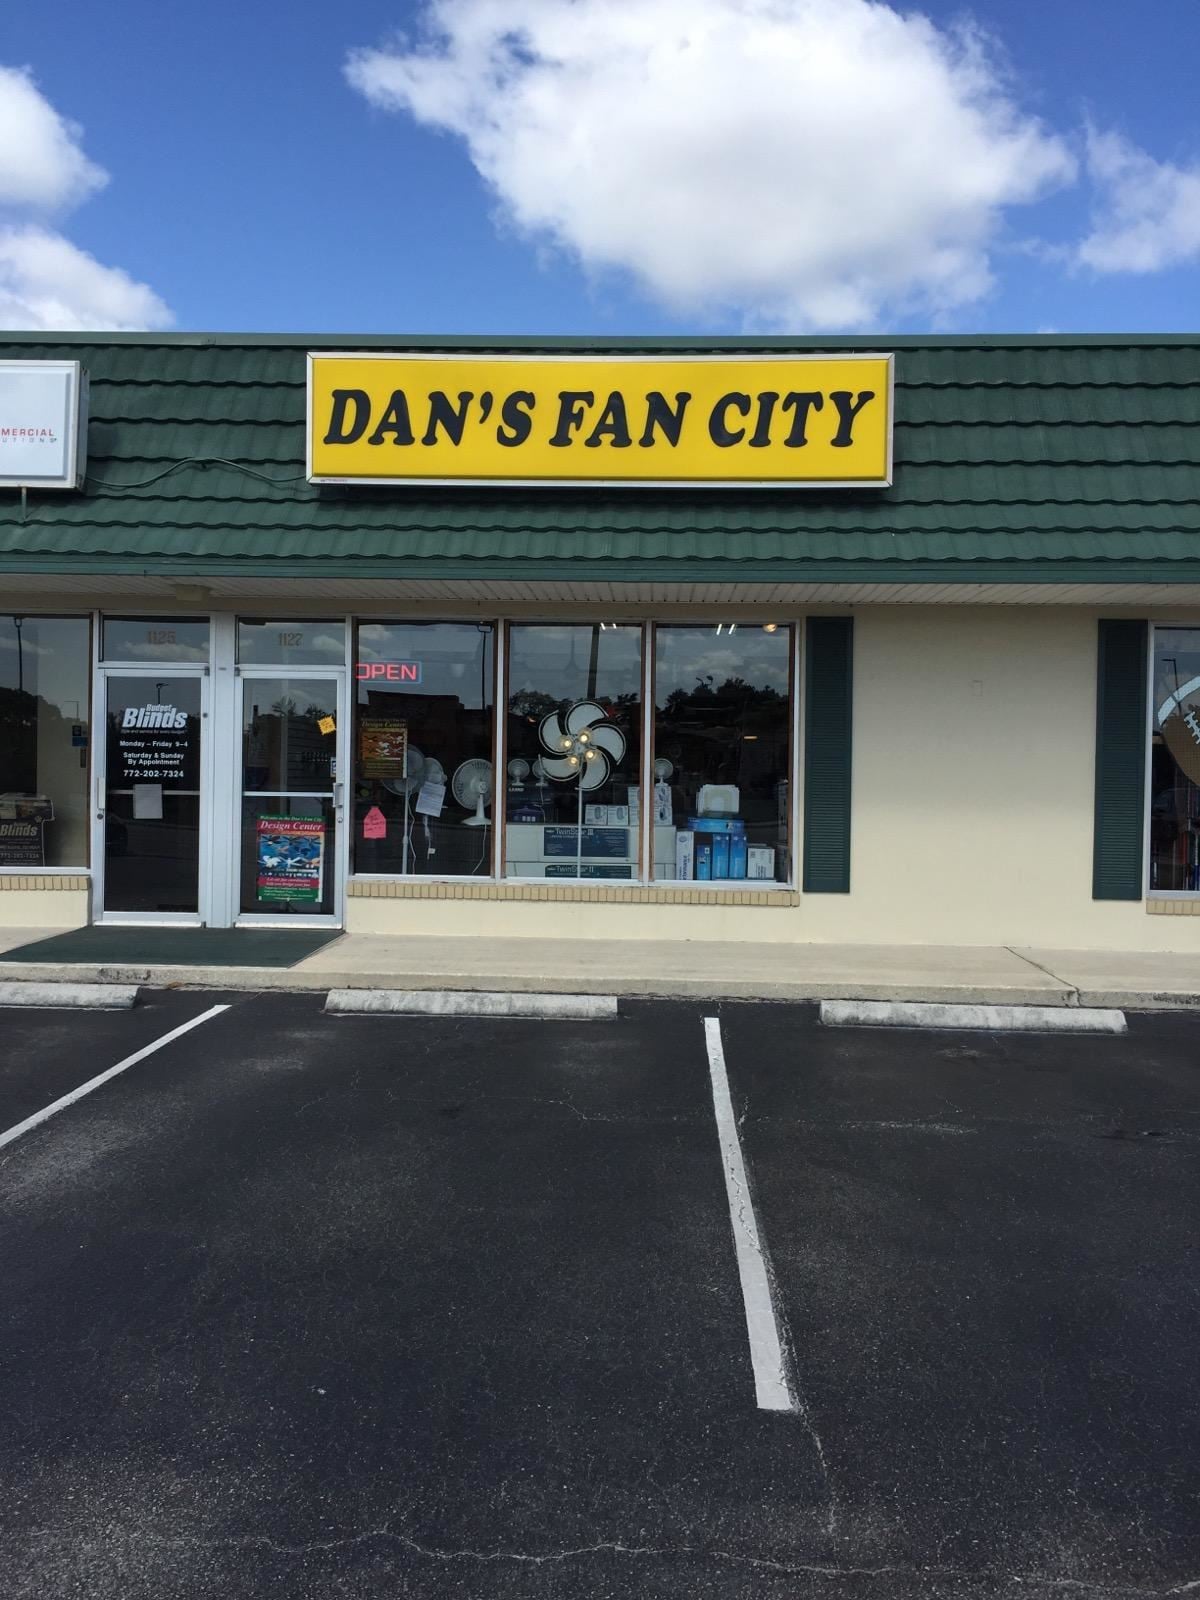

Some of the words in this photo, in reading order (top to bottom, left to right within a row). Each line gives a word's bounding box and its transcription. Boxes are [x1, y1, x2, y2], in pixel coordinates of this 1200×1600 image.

[323, 389, 536, 448] DAN'S
[548, 390, 692, 448] FAN
[708, 390, 875, 448] CITY
[148, 631, 176, 645] 1125
[278, 633, 303, 647] 1127
[356, 663, 418, 681] OPEN
[122, 708, 187, 728] Blinds
[152, 740, 173, 748] Friday
[160, 752, 184, 760] Sunday
[0, 824, 38, 836] Blinds
[260, 821, 290, 830] Design
[292, 822, 322, 831] Center
